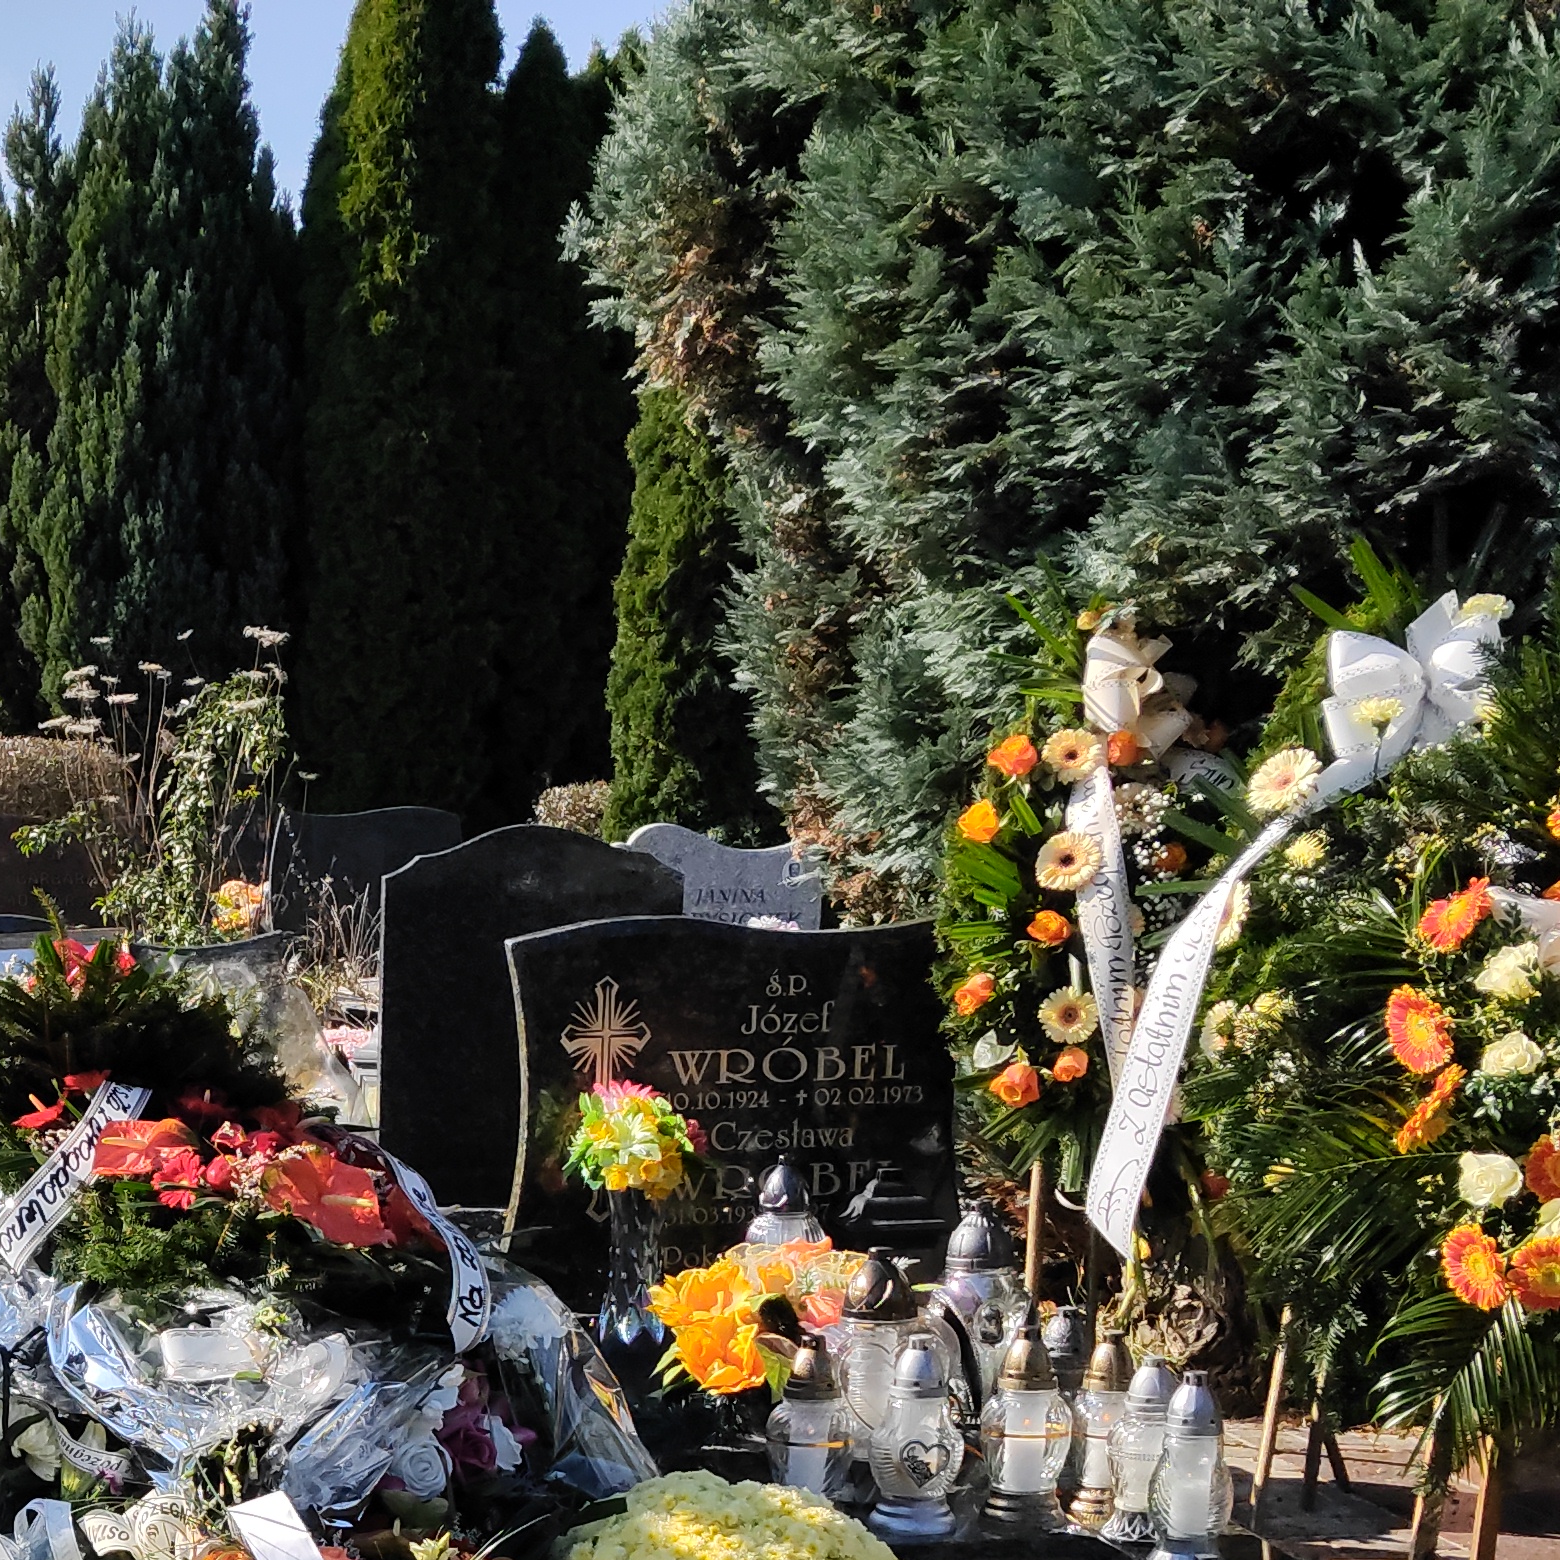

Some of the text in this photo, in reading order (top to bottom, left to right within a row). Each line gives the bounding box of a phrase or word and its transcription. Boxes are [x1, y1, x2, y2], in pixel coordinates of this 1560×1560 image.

[695, 888, 767, 906] JANINA
[740, 1000, 835, 1035] Józef
[667, 1036, 905, 1087] WRÓBEL
[814, 1086, 924, 1107] 02.02.1973
[710, 1118, 855, 1152] Czesława
[457, 1284, 483, 1327] Na
